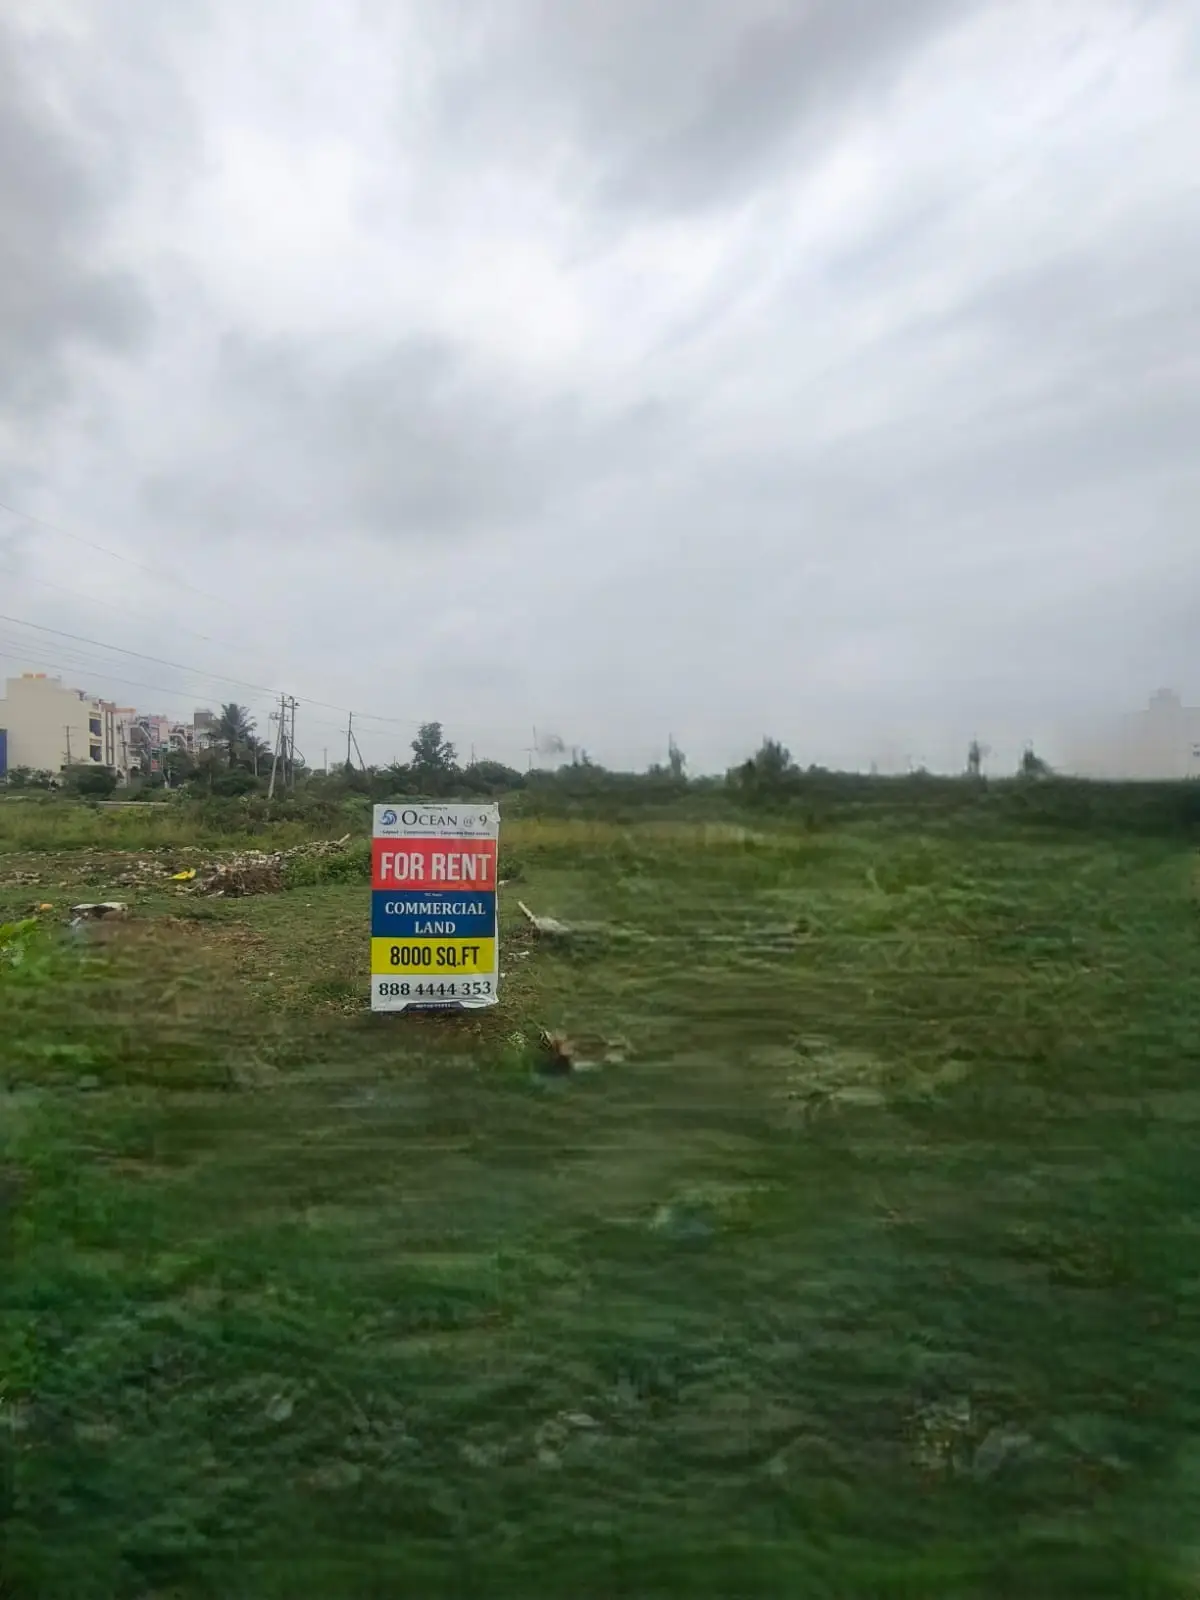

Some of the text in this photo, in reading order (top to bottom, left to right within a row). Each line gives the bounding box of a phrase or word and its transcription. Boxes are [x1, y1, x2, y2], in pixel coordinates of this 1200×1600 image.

[402, 810, 457, 826] OCEAN
[479, 814, 488, 827] 9
[381, 852, 492, 881] FOR RENT
[385, 902, 486, 915] COMMERCIAL
[415, 921, 456, 934] LAND
[390, 946, 480, 967] 8000 SQ.FT
[379, 981, 491, 996] 888 4444 353
